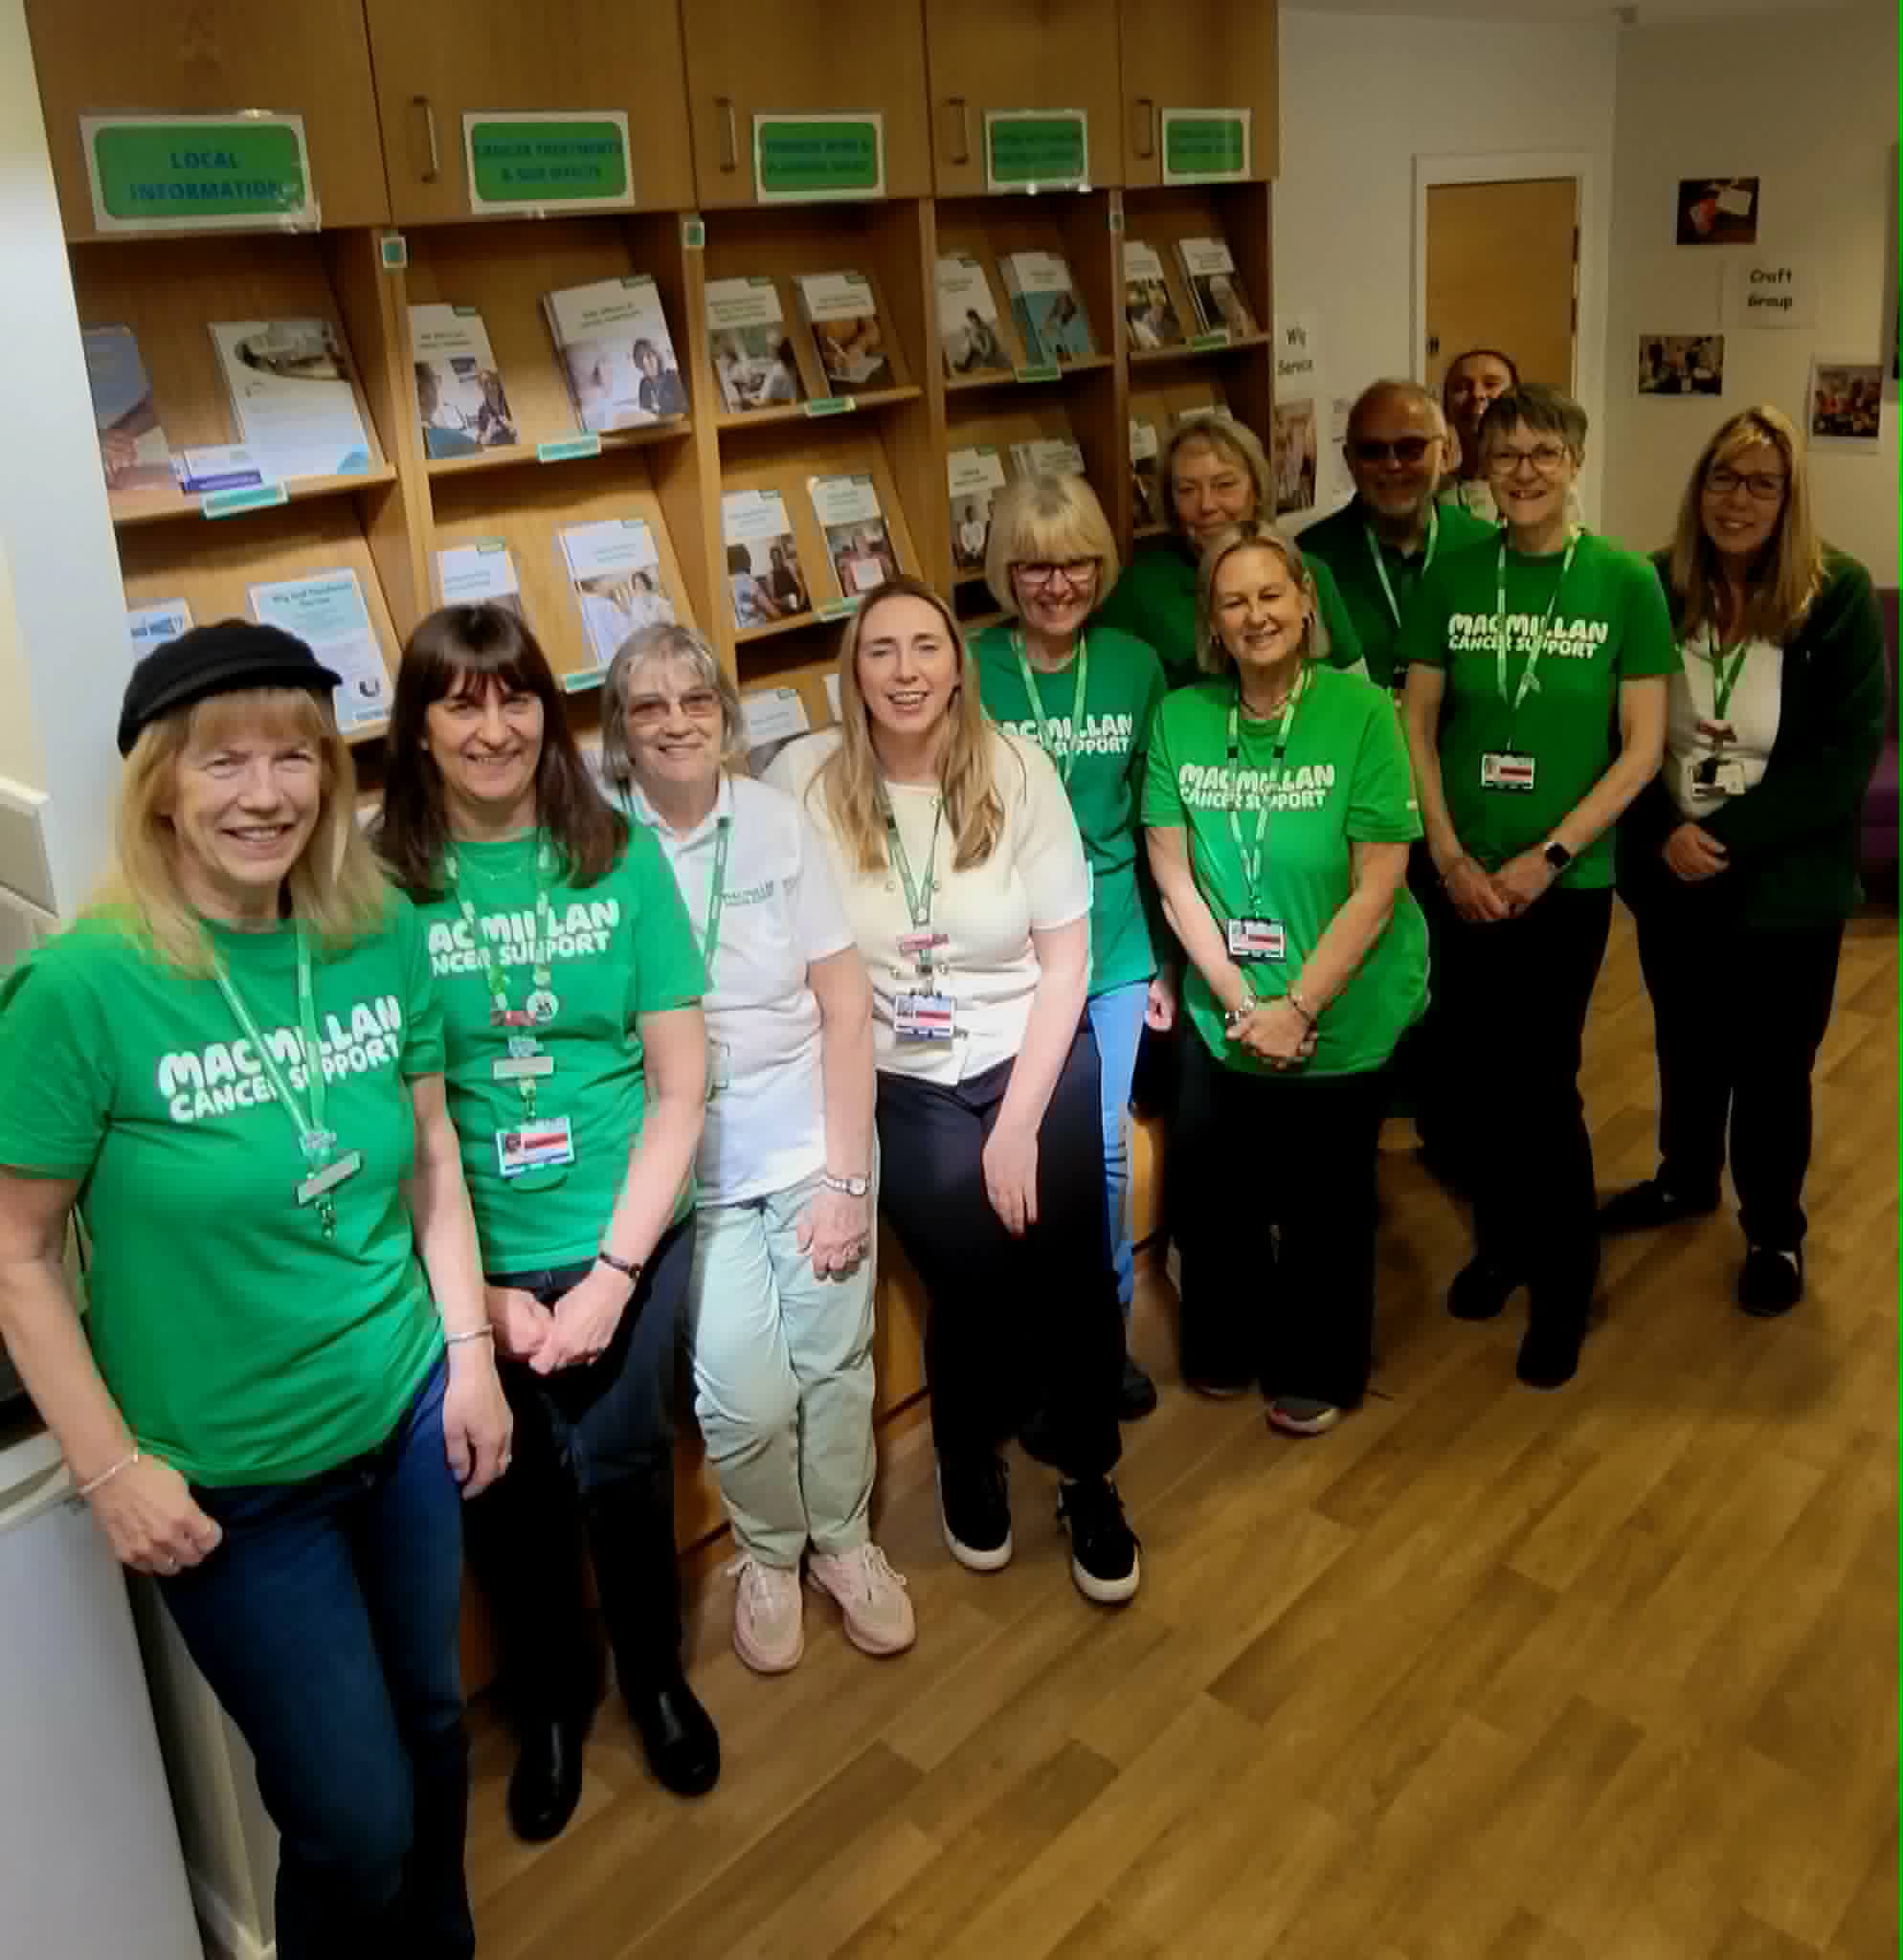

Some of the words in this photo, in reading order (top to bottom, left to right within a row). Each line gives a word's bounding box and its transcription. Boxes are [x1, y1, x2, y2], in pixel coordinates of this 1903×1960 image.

[169, 150, 238, 169] LOCAL
[128, 179, 286, 200] INFORMATION
[1749, 267, 1792, 284] Craft
[1747, 292, 1792, 314] Group
[1448, 634, 1511, 652] CANCR
[1514, 635, 1598, 659] SUPORT
[996, 713, 1132, 738] ACMILAN
[1178, 763, 1334, 795] MACMILAN
[1178, 787, 1243, 810] CANCR
[1245, 789, 1327, 812] SUPORT
[428, 899, 620, 954] ACMILLAN
[431, 946, 493, 976] NCER
